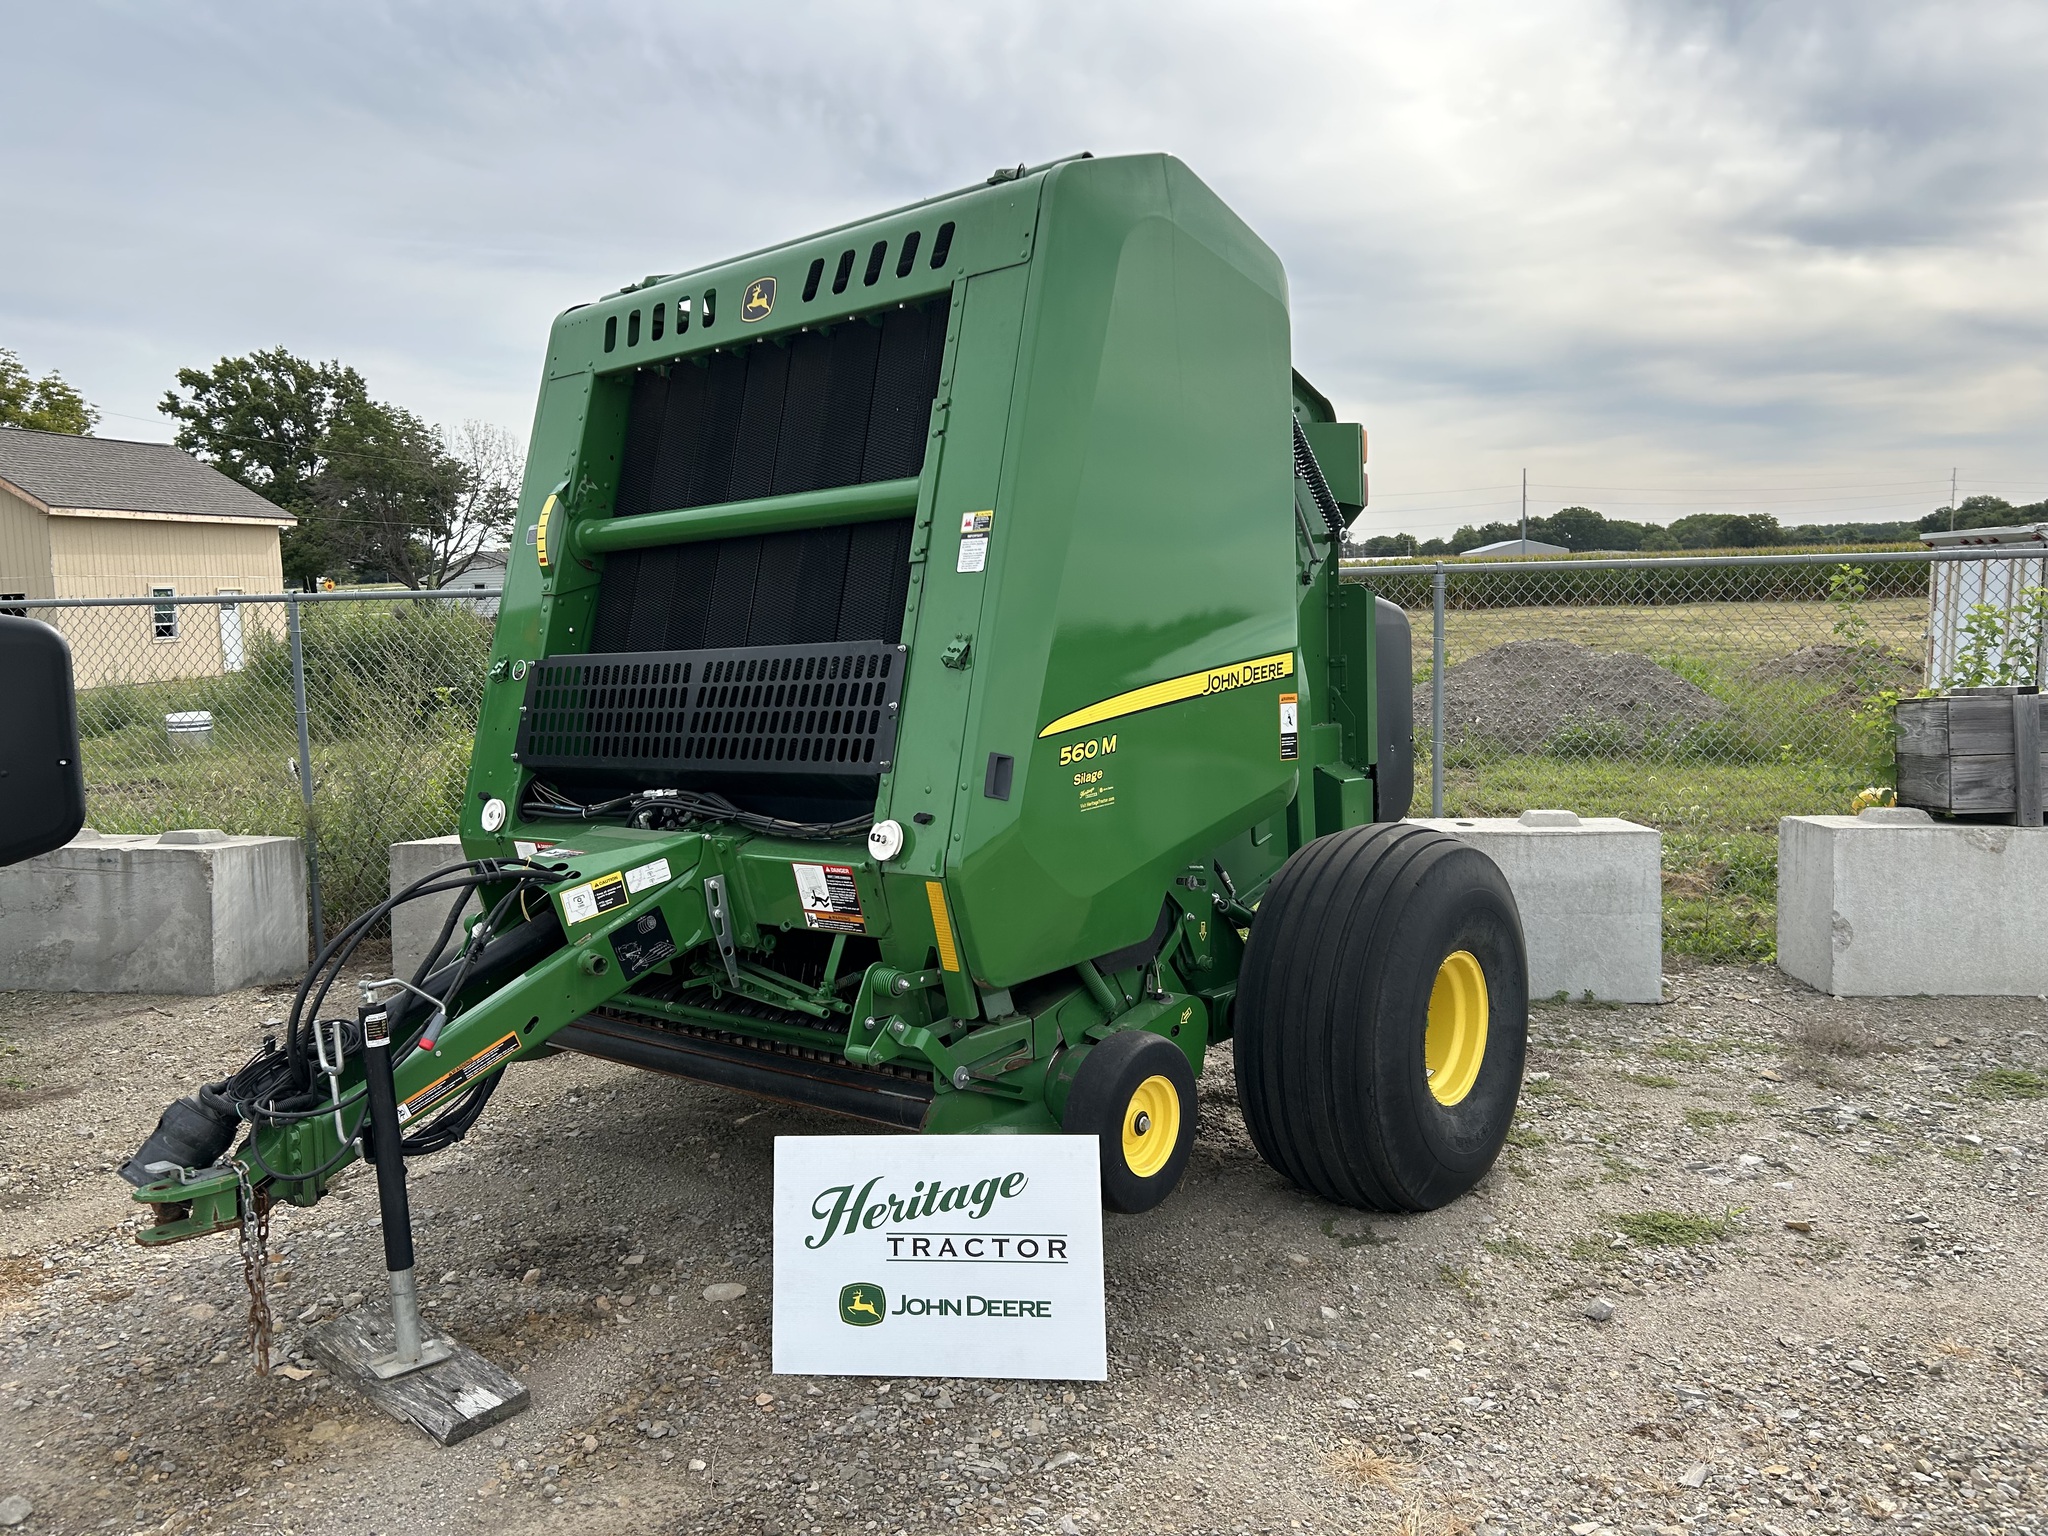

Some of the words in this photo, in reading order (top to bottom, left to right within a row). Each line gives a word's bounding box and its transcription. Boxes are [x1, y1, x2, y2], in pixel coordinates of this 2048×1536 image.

[1203, 671, 1240, 693] JOHN
[1242, 662, 1284, 685] DEERE
[1059, 740, 1098, 766] 560
[1100, 734, 1117, 756] M
[1073, 769, 1103, 786] Silage
[599, 876, 619, 886] CAUTION
[805, 1171, 1029, 1250] Heritage
[886, 1237, 1068, 1259] TRACTOR
[891, 1294, 962, 1317] JOHN
[966, 1295, 1052, 1318] DEERE
